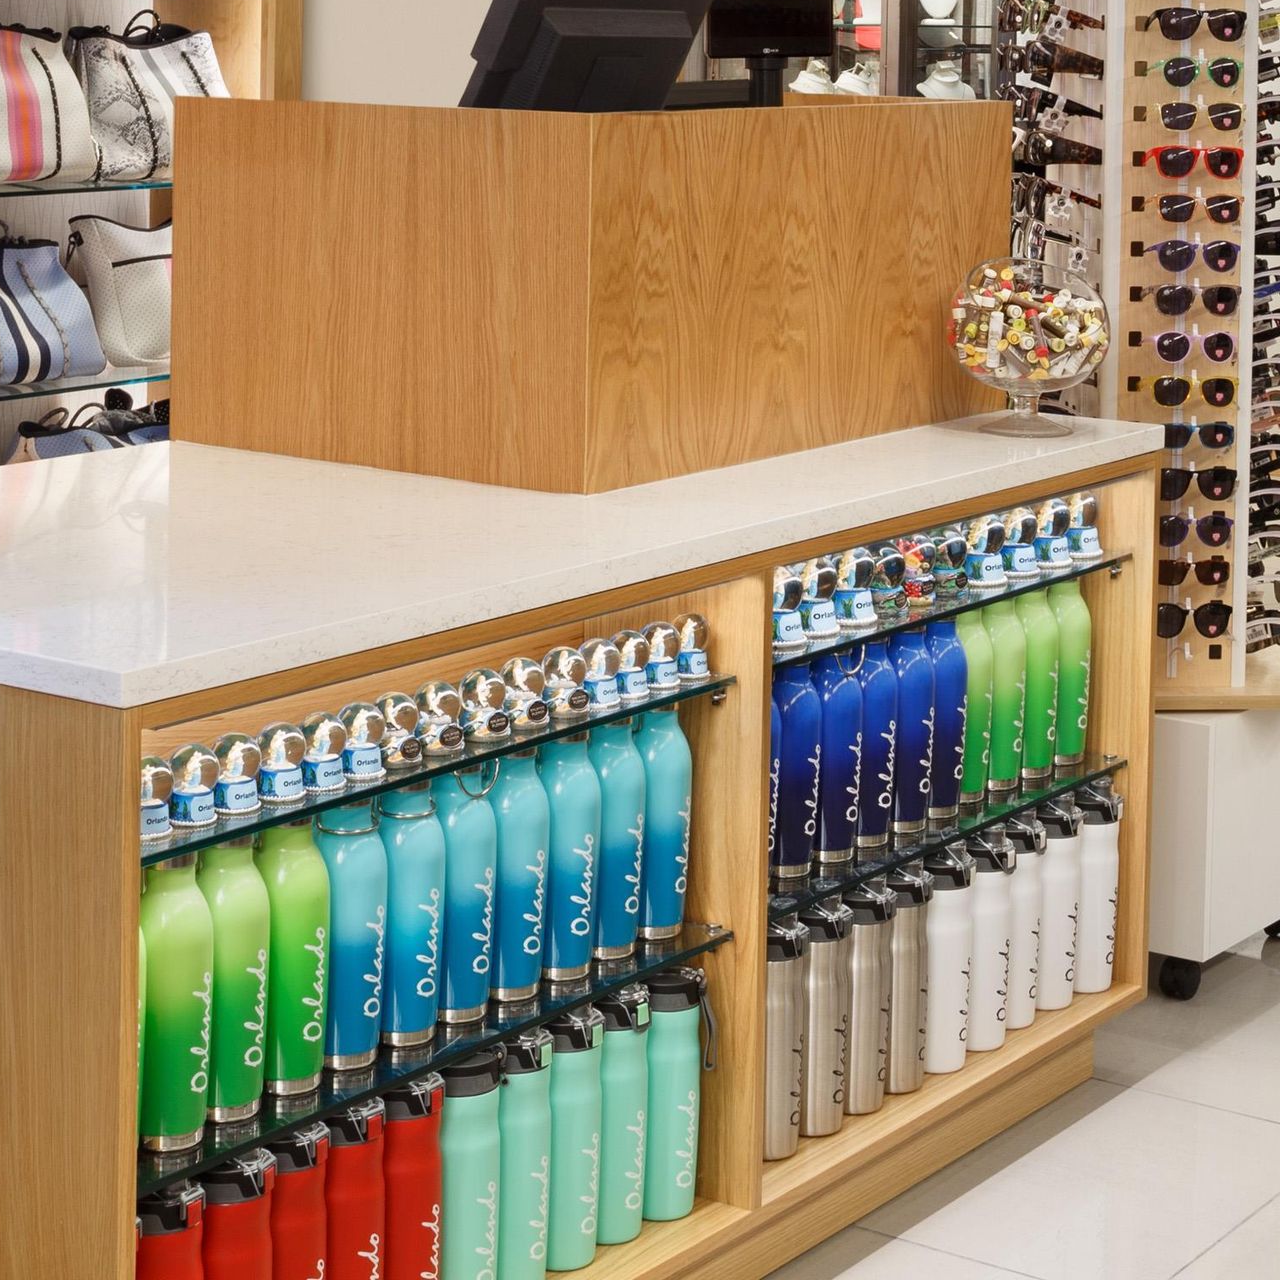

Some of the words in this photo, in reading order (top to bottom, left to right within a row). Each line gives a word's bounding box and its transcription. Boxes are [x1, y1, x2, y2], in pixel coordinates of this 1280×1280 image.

[804, 743, 821, 836] Orlando
[846, 731, 862, 822] Orlando
[878, 720, 896, 808] Orlando
[920, 706, 935, 794] Orlando
[570, 833, 594, 937] Orlando
[625, 813, 644, 915] Orlando
[675, 796, 692, 895] Orlando
[416, 888, 440, 998] Orlando
[472, 867, 493, 975] Orlando
[523, 849, 545, 956] Orlando
[243, 948, 267, 1068] Orlando
[302, 926, 325, 1043] Orlando
[363, 904, 385, 1018] Orlando
[996, 938, 1010, 1022] Orlando
[190, 971, 212, 1094] Orlando
[832, 1014, 848, 1105] Orlando
[579, 1132, 599, 1235] Orlando
[624, 1110, 645, 1210] Orlando
[675, 1090, 697, 1189] Orlando
[420, 1203, 440, 1280] lando
[529, 1155, 550, 1261] Orlando
